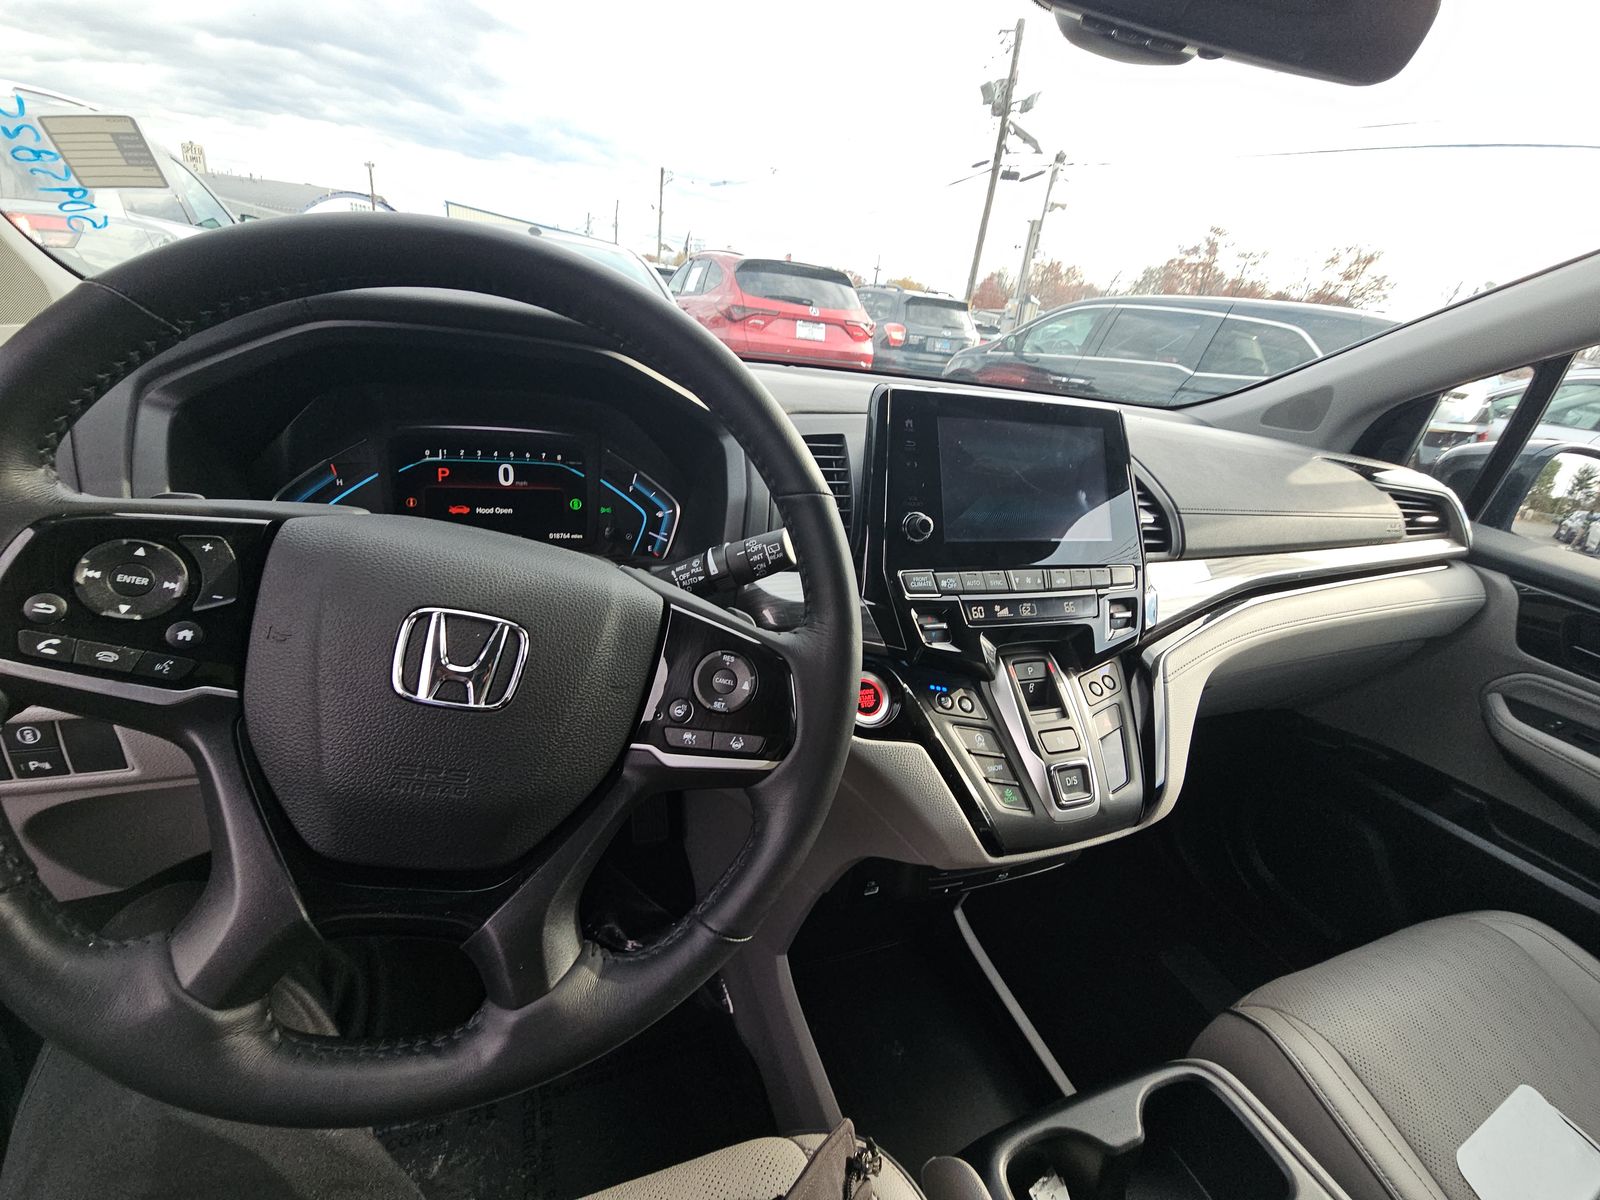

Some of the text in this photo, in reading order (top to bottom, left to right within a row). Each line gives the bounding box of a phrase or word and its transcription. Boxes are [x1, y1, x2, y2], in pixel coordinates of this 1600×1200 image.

[182, 144, 203, 155] SPEED
[183, 154, 202, 164] LIMIT
[437, 467, 450, 482] P
[498, 463, 515, 487] 0
[336, 478, 343, 486] H
[475, 506, 513, 516] Hood Open
[548, 532, 571, 540] 018764
[750, 544, 763, 553] OFF
[752, 552, 764, 562] INT
[690, 566, 703, 575] PULL
[116, 574, 149, 585] ENTER
[678, 572, 691, 581] OFF
[682, 578, 698, 587] AUTO
[972, 606, 985, 618] 60
[722, 654, 735, 662] RES
[1027, 666, 1034, 676] P
[715, 677, 734, 686] CANCEL
[713, 700, 726, 709] SET
[987, 764, 1003, 773] SNOW
[1065, 776, 1078, 786] D/S
[1004, 796, 1018, 804] ECON
